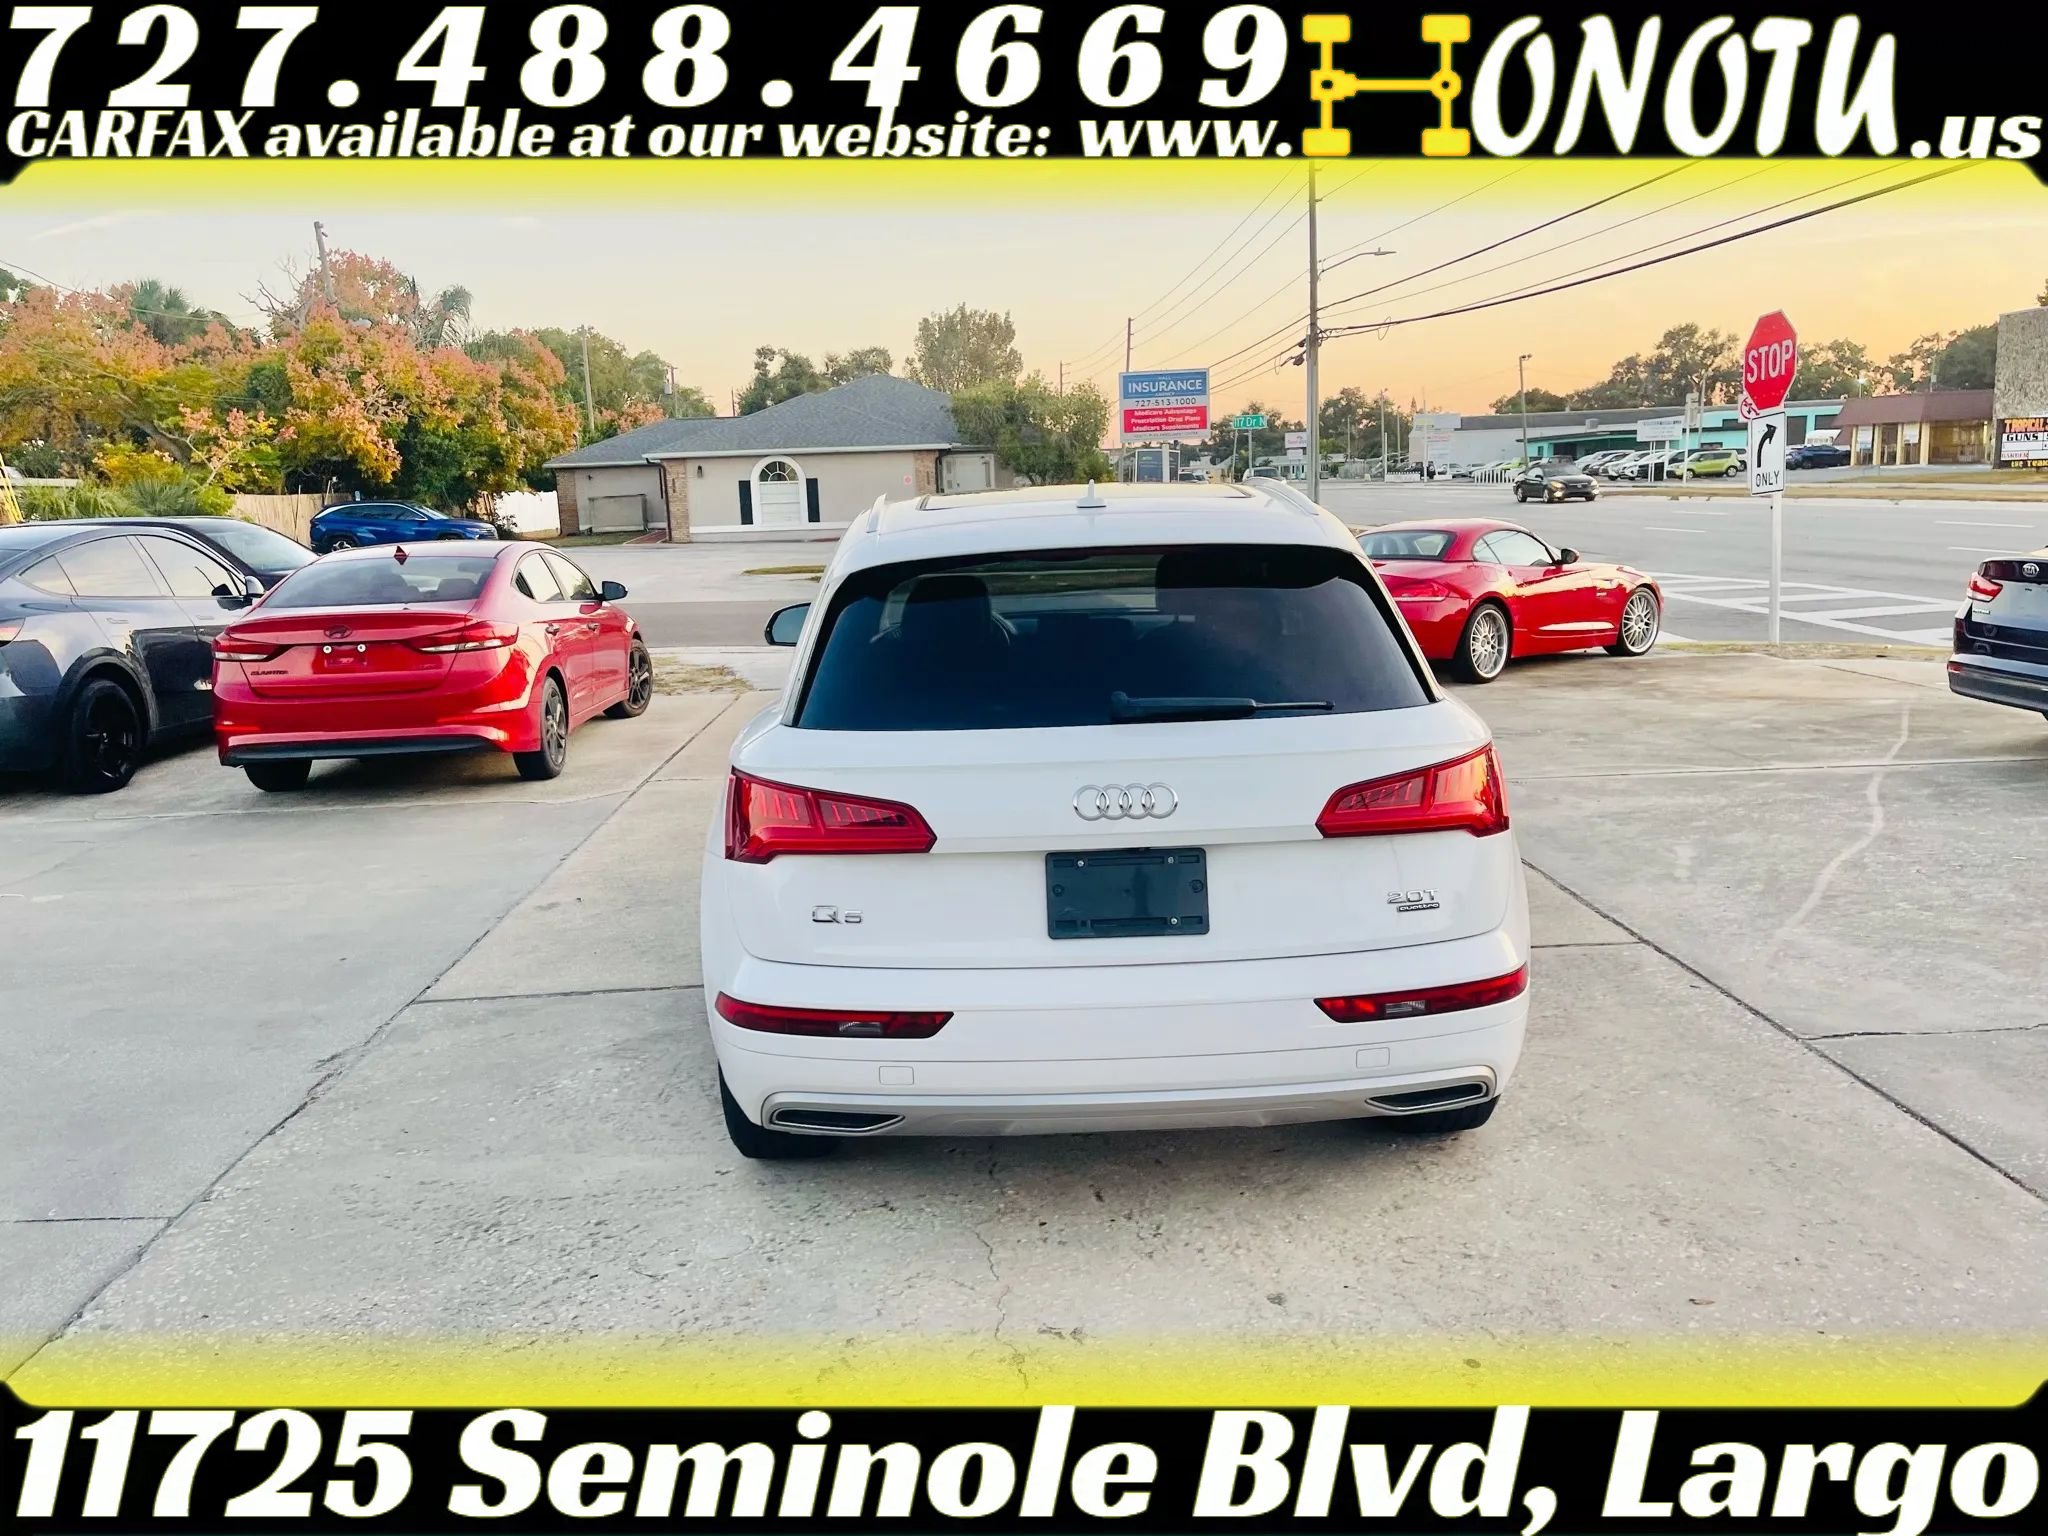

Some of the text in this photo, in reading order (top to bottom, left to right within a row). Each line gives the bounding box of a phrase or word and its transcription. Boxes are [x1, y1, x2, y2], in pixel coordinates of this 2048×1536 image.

[1746, 338, 1794, 384] STOP
[1128, 379, 1203, 393] INSURANCE
[1135, 397, 1197, 407] 727-513-1000
[1246, 417, 1257, 427] Dr
[1259, 416, 1266, 426] N
[2006, 433, 2039, 441] GUNS
[1755, 470, 1780, 488] ONLY
[1398, 902, 1439, 912] quattro
[811, 905, 862, 924] Q5
